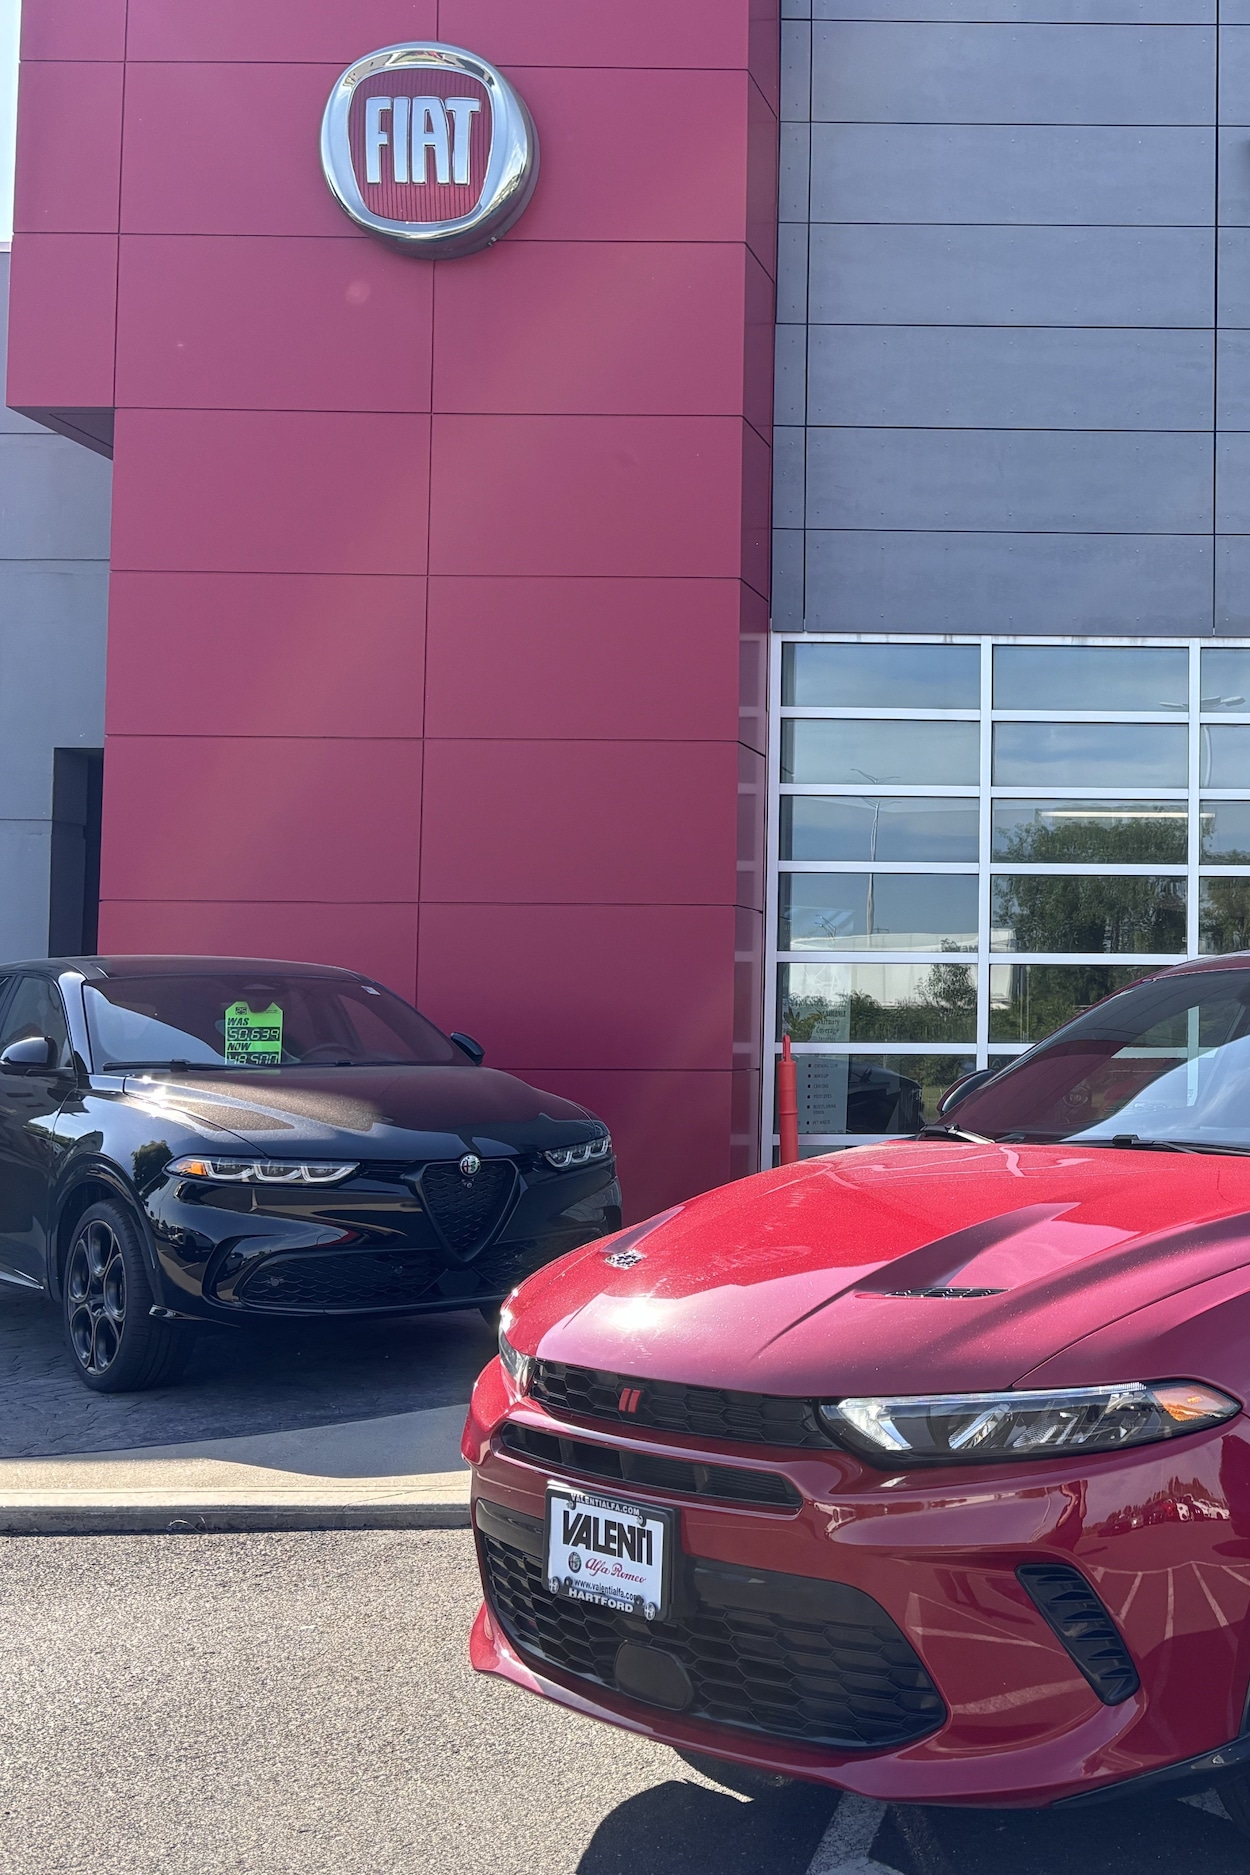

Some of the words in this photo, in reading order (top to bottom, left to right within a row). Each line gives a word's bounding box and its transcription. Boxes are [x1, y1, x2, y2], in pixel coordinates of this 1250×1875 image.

[365, 95, 481, 186] FIAT
[227, 1017, 250, 1026] WAS
[227, 1042, 252, 1051] NOW
[570, 1493, 640, 1516] VALENTIALFA.COM
[562, 1510, 653, 1566] VALENTI
[585, 1557, 611, 1577] Alfa
[610, 1562, 647, 1584] Romeo
[568, 1587, 634, 1613] HARTFORD
